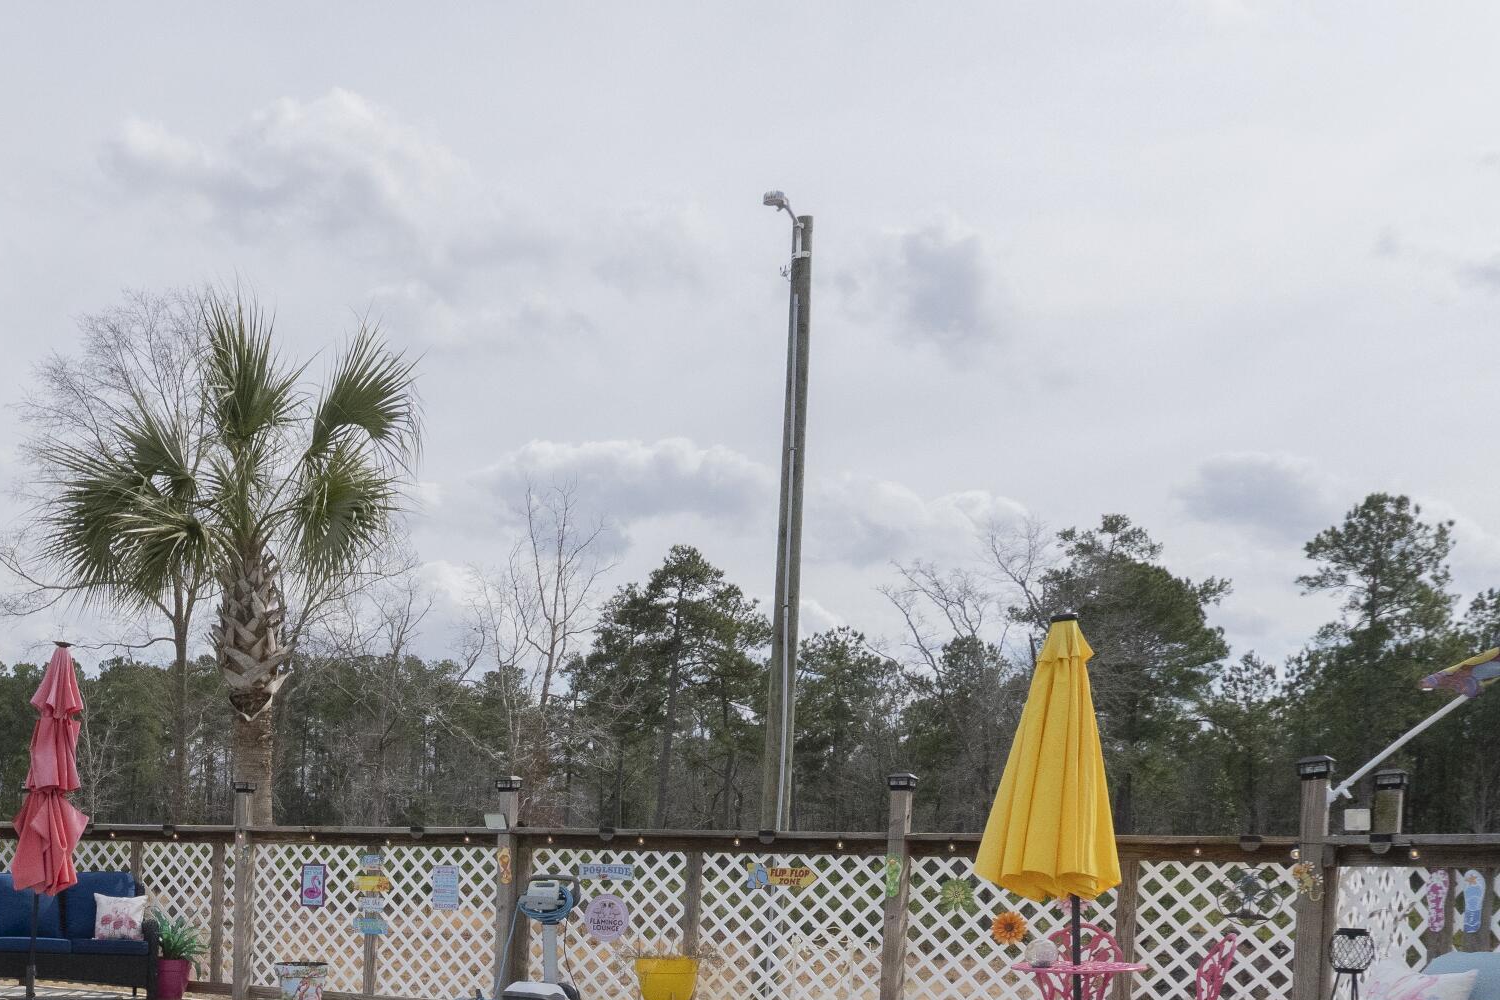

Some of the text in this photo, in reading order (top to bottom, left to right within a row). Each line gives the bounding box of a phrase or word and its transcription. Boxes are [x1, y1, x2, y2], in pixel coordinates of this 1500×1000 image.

[583, 866, 632, 877] POOLSIDE
[770, 868, 810, 878] FLIP FLOP
[590, 918, 623, 927] FLAMINGO
